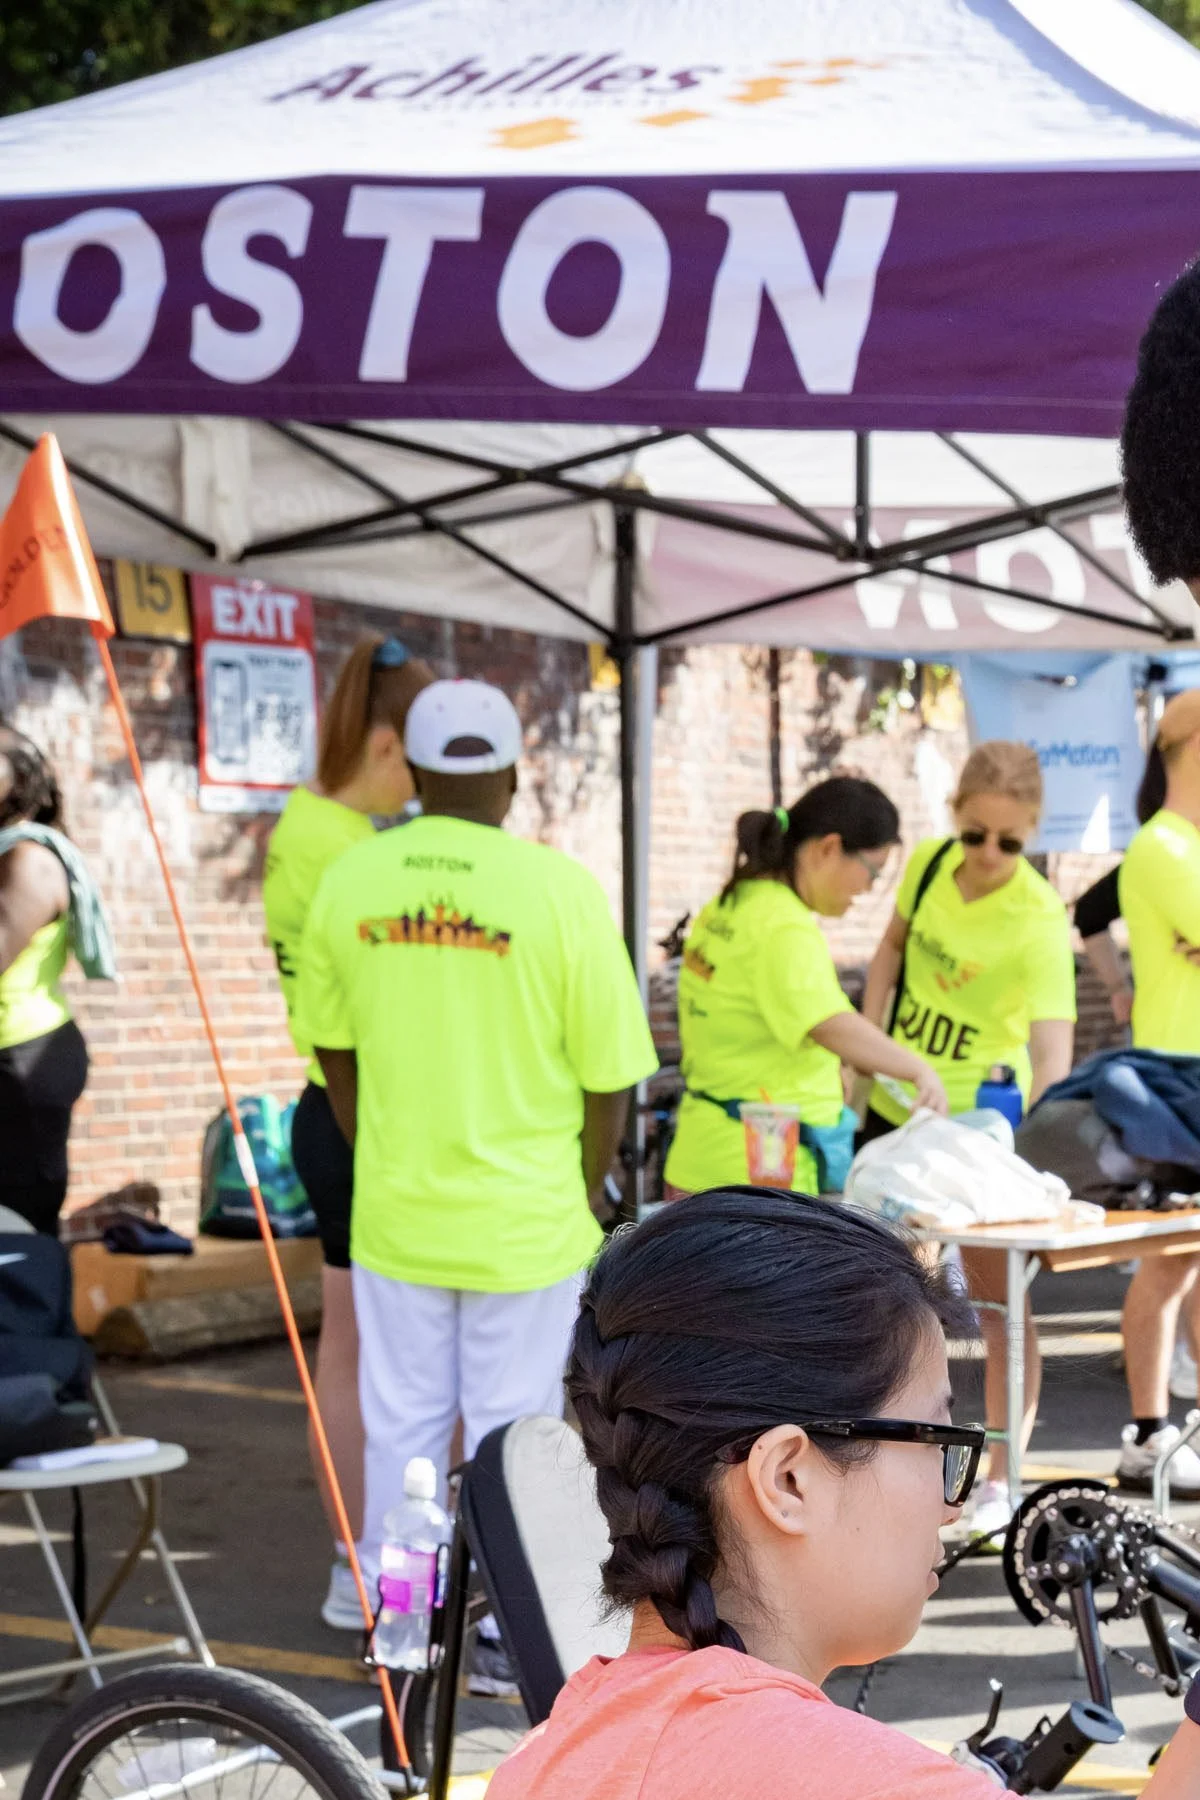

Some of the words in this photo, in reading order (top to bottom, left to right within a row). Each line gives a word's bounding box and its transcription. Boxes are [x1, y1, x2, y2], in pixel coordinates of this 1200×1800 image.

[270, 52, 723, 104] Achilles
[13, 184, 898, 395] OSTON
[209, 584, 299, 641] EXIT
